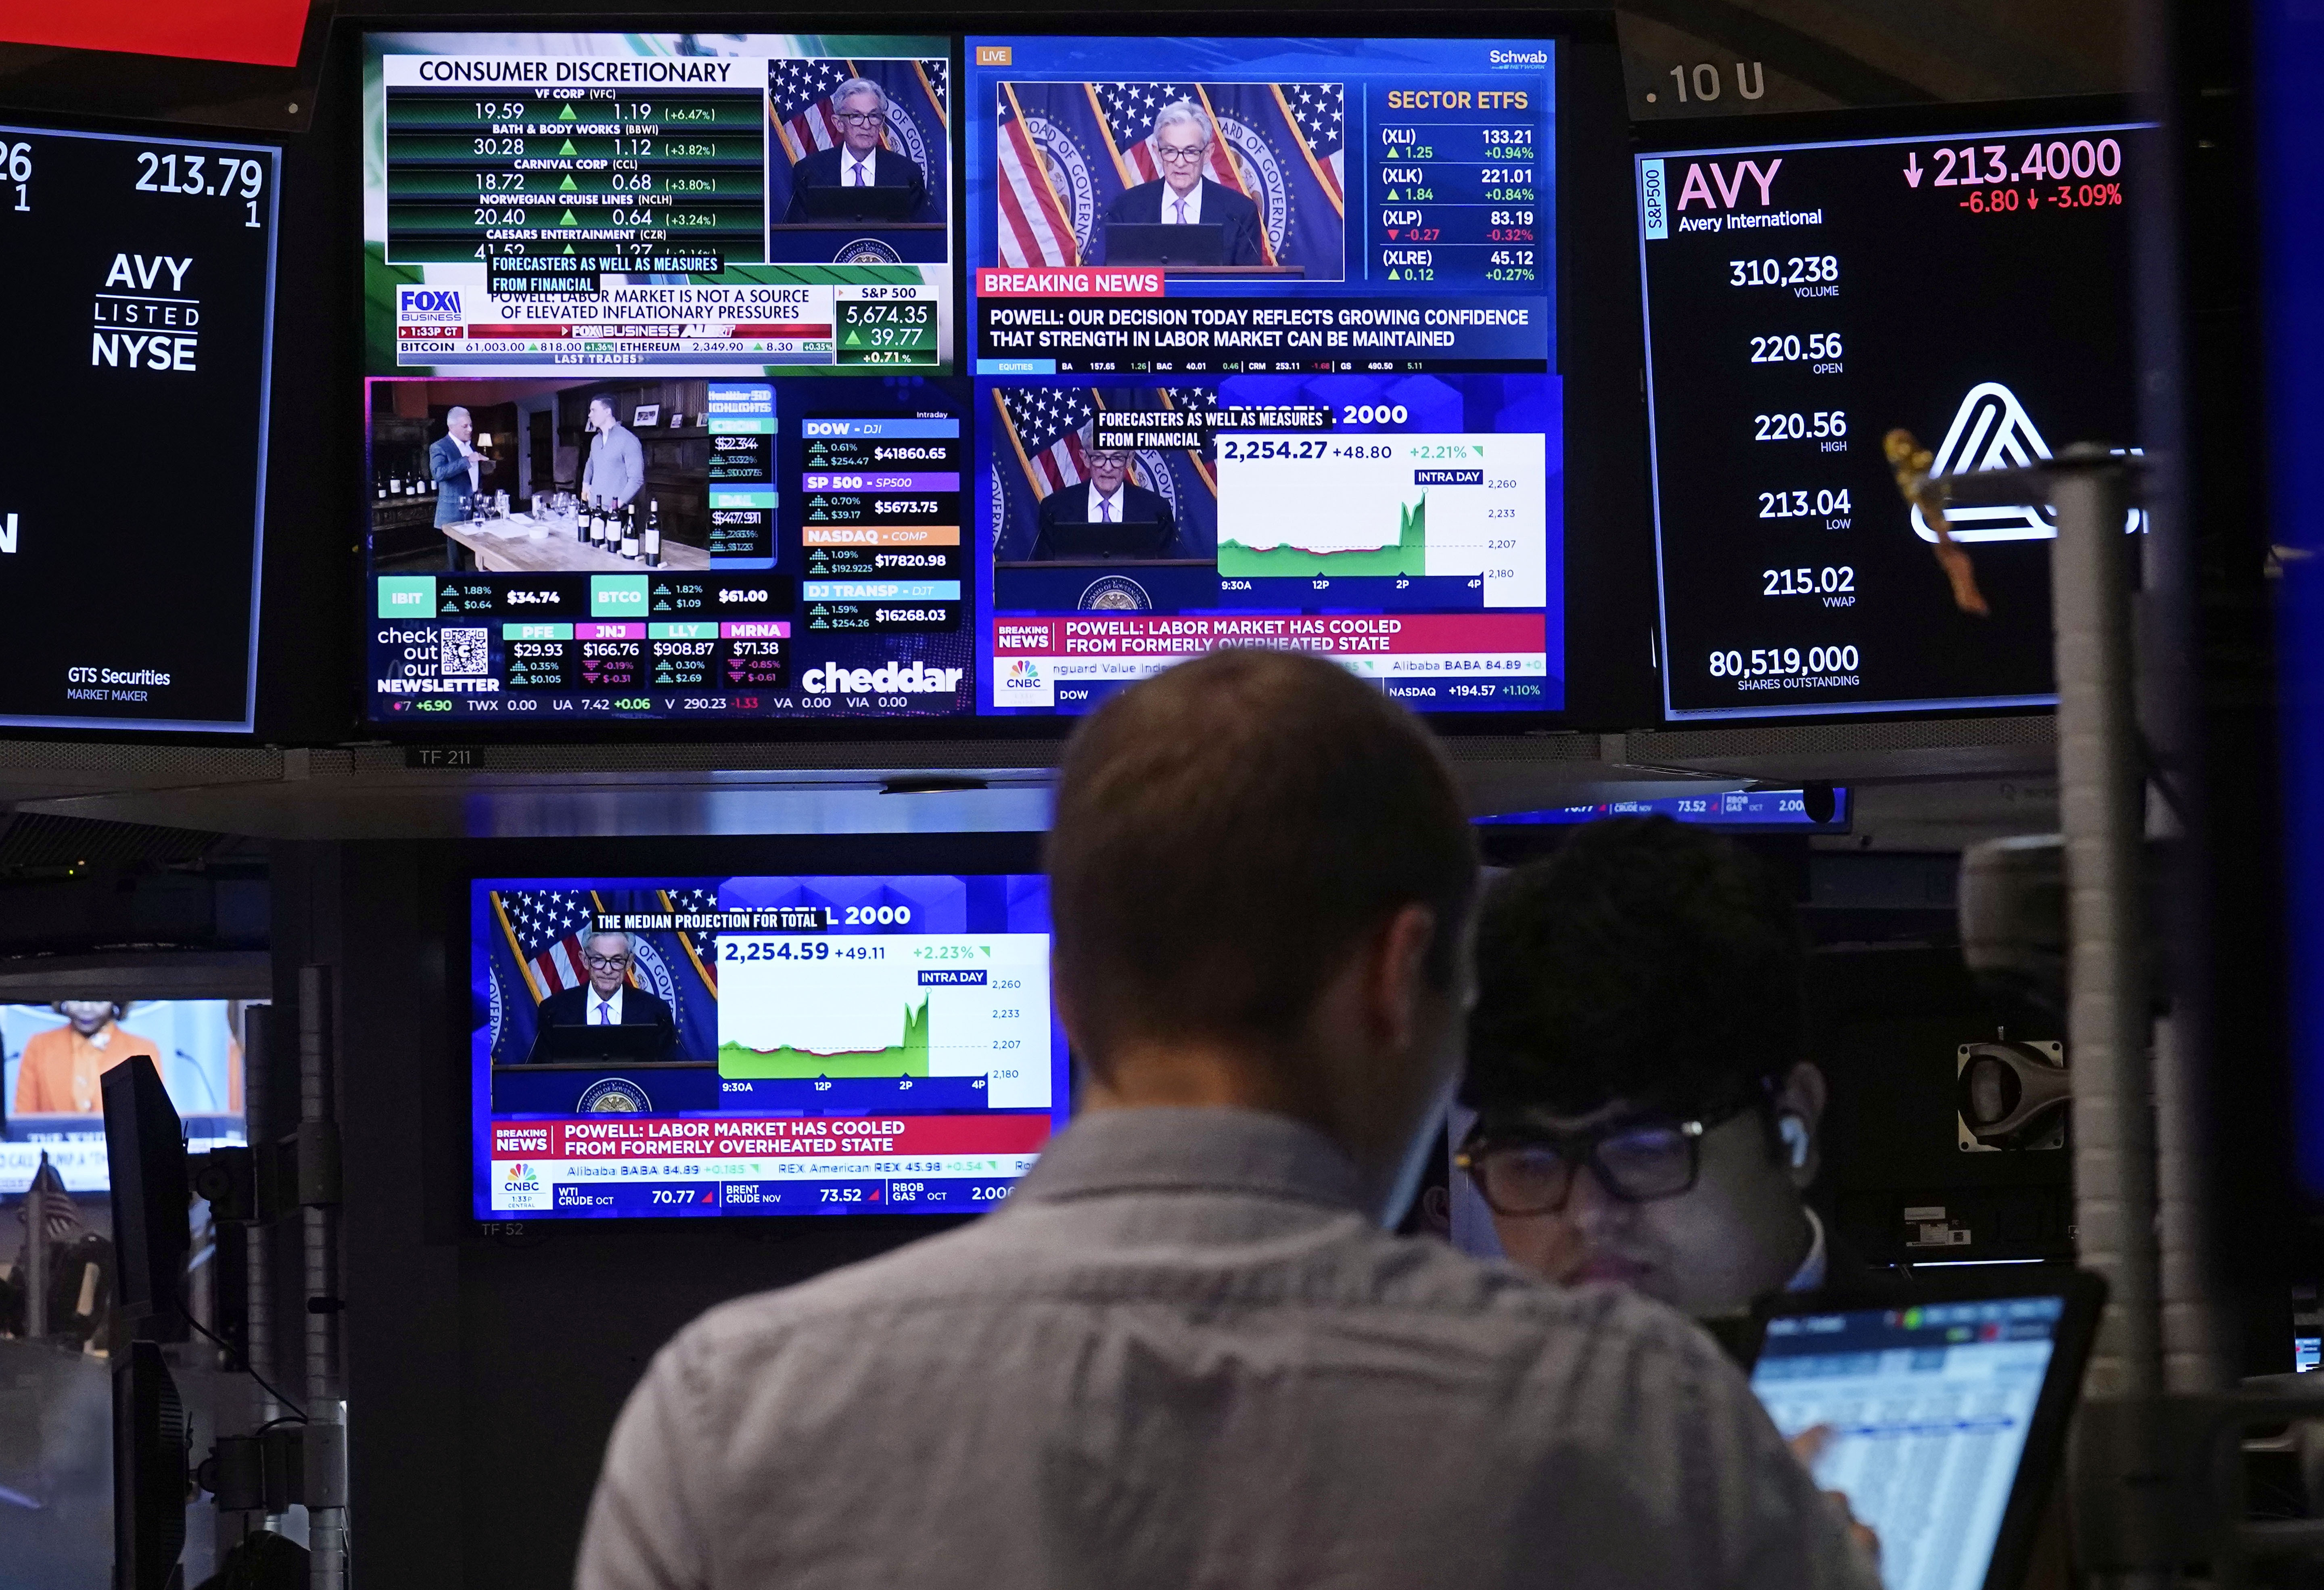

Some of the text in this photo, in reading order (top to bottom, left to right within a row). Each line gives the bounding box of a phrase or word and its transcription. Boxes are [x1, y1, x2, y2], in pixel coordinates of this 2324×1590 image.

[982, 51, 1006, 61] LIVE
[1490, 50, 1547, 64] Schwab
[420, 61, 731, 82] CONSUMER DISCRETIONARY
[1737, 62, 1764, 99] U
[535, 88, 616, 100] VF CORP (VFC)
[1388, 91, 1528, 109] SECTOR ETFS
[475, 103, 715, 122] 19.59 1.19 (+6.47%)
[1382, 128, 1532, 145] (XLI) 133.21
[1405, 146, 1534, 159] 1.25 +0.94%
[514, 159, 638, 171] CARNIVAL CORP (CCL)
[1933, 138, 2121, 186] 213.4000
[136, 152, 262, 198] 213.79
[475, 174, 716, 192] 18.72 0.68 (+3.80%)
[1677, 159, 1783, 210] AVY
[15, 184, 30, 211] 1
[1646, 169, 1662, 228] S&P500
[1960, 183, 2122, 213] -6.80 -3.09%
[246, 201, 260, 227] 1
[1382, 210, 1533, 226] (XLP) 83.19
[1679, 209, 1822, 232] Avery International
[486, 229, 667, 241] CAESARS ENTERTAINMENT (CZR)
[493, 258, 717, 271] FORECASTERS AS WELL AS MEASURES
[1730, 256, 1838, 287] 310,238
[105, 254, 193, 291] AVY
[493, 278, 594, 291] FROM FINANCIAL
[985, 274, 1158, 292] BREAKING NEWS
[862, 288, 916, 298] S&P 500
[1794, 286, 1839, 298] VOLUME
[402, 291, 461, 313] FOX
[94, 303, 199, 326] LISTED
[846, 306, 927, 326] 5,674.35
[991, 309, 1528, 325] POWELL: OUR DECISION TODAY REFLECTS GROWING CONFIDENCE
[871, 328, 923, 346] 39.77
[92, 333, 197, 371] NYSE
[401, 343, 581, 352] BITCOIN 61,003.00 818.00
[1750, 333, 1842, 362] 220.56
[555, 354, 637, 364] LAST TRADES
[1813, 363, 1843, 374] OPEN
[1343, 406, 1408, 424] 2000
[807, 423, 882, 435] DOW DJI
[1755, 411, 1847, 441] 220.56
[874, 447, 946, 460] $41860.65
[1224, 441, 1467, 462] 2,254.27 +48.80 +2.21%
[1821, 441, 1847, 452] HIGH
[1418, 472, 1480, 482] INTRA DAY
[1488, 479, 1516, 490] 2,260
[1759, 489, 1851, 518] 213.04
[1827, 519, 1851, 529] LOW
[808, 530, 928, 544] NASDAQ COMP
[875, 554, 946, 568] $17820.98
[1221, 580, 1481, 590] 9:30A 12P 2P 4P
[1763, 566, 1854, 596] 215.02
[598, 591, 641, 603] BTCO
[719, 589, 767, 603] $61.00
[1823, 596, 1856, 608] VWAP
[378, 627, 438, 643] check
[522, 626, 554, 638] PFE
[404, 646, 438, 660] out
[514, 643, 563, 657] $29.93
[530, 662, 559, 670] 0.35%
[1710, 645, 1859, 679] 80,519,000
[69, 667, 170, 685] GTS Securities
[404, 663, 438, 676] our
[802, 661, 963, 694] cheddar
[1007, 679, 1041, 688] CNBC
[1738, 675, 1860, 691] SHARES OUTSTANDING
[378, 678, 499, 692] NEWSLETTER
[1389, 685, 1540, 697] NASDAQ +194.57 +1.10%
[67, 688, 148, 701] MARKET MAKER
[419, 750, 470, 764] TF 211
[598, 914, 817, 929] THE MEDIAN PROJECTION FOR TOTAL
[725, 942, 974, 964] 2,254.59 +49.11 +2.23%
[496, 1130, 547, 1138] BREAKING
[565, 1121, 905, 1138] POWELL: LABOR MARKET HAS COOLED
[496, 1138, 547, 1152] NEWS
[565, 1138, 893, 1155] FROM FORMERLY OVERHEATED STATE
[558, 1188, 578, 1196] WTI
[652, 1190, 695, 1204] 70.77
[558, 1196, 614, 1205] CRUDE OCT
[483, 1223, 523, 1236] TF 52
